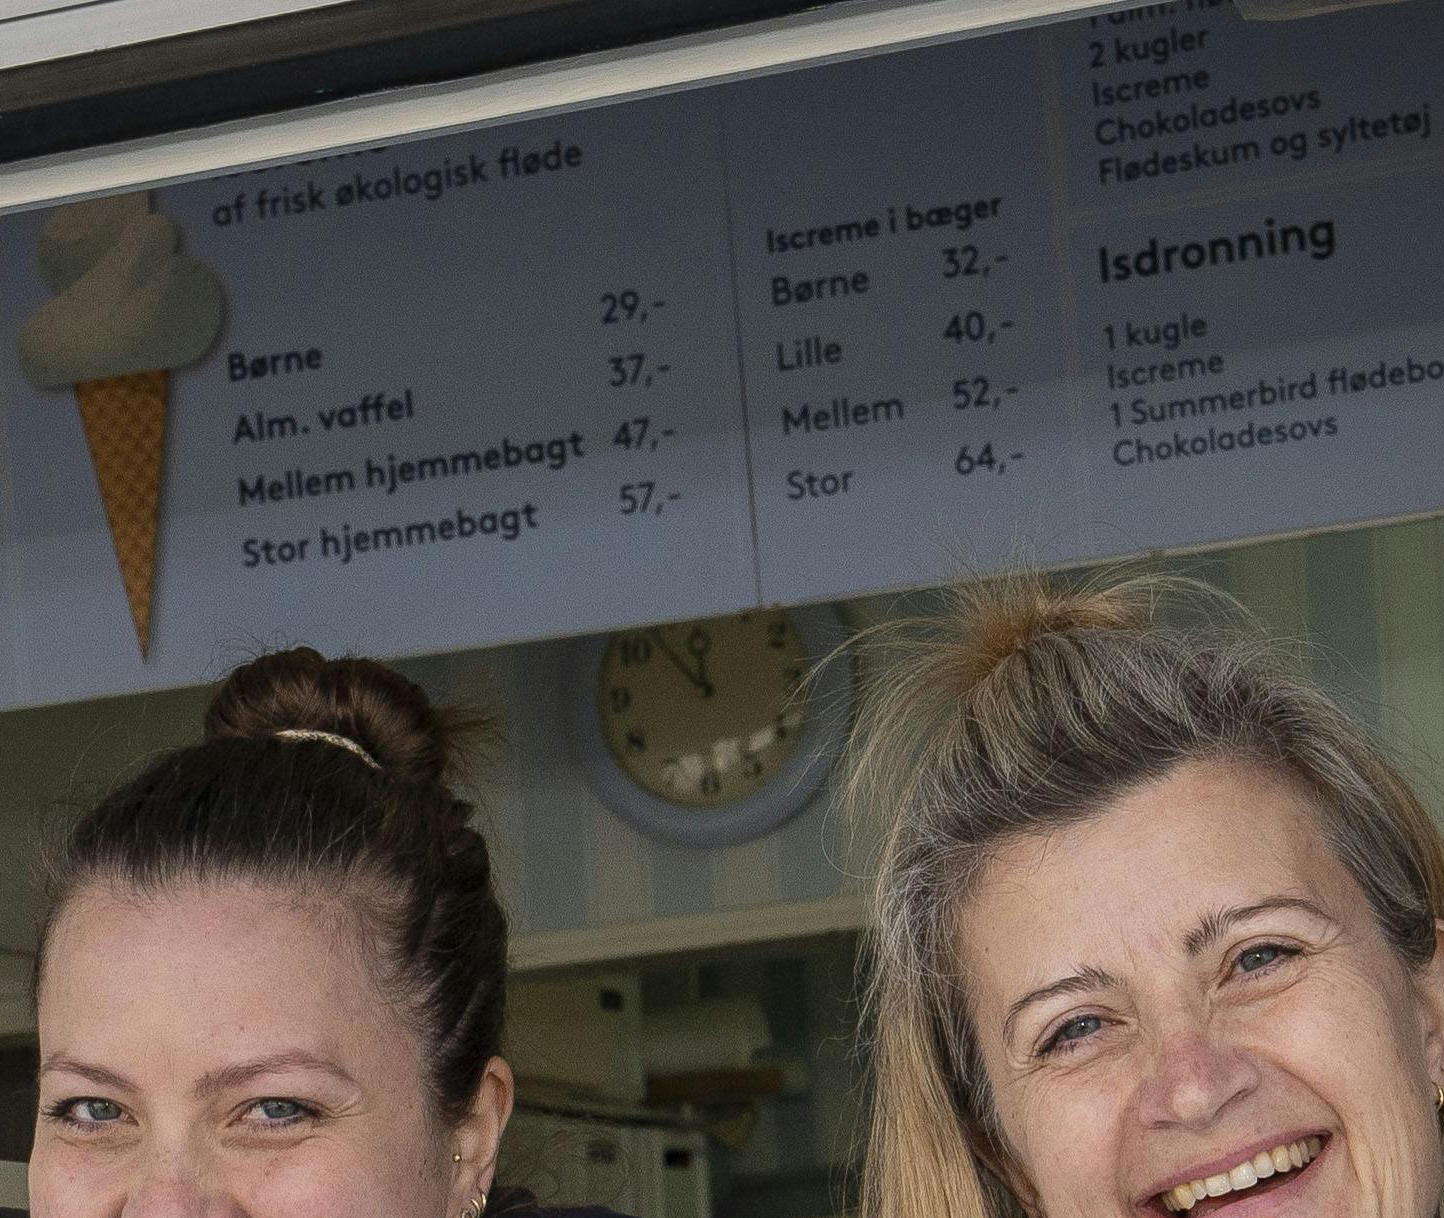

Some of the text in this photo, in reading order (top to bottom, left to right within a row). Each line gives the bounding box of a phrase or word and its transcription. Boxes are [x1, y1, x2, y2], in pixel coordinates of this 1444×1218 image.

[1089, 27, 1209, 68] 2 kugler
[1092, 70, 1210, 107] Iscreme
[1094, 88, 1322, 147] Chokoladesovs
[1098, 105, 1432, 185] Flødeskum og syltetøj
[212, 191, 246, 227] af
[257, 180, 326, 220] frisk
[335, 156, 488, 207] økologisk
[498, 140, 584, 180] fløde
[766, 197, 1003, 253] Iscreme i bæger
[1098, 216, 1337, 284] Isdronning
[771, 244, 1009, 306] Børne 32,-
[227, 290, 666, 383] Børne 29,-
[776, 311, 1015, 372] Lille 40,-
[1103, 314, 1208, 352] 1 kugle
[232, 354, 672, 446] Alm. vaffel 37,-
[1107, 352, 1225, 391] Iscreme
[782, 376, 1019, 435] Mellem 52,-
[1110, 403, 1123, 429] 1
[1130, 374, 1318, 427] Summerbird
[237, 418, 677, 507] Mellem hjemmebagt 47,-
[1112, 414, 1339, 468] Chokoladesovs
[786, 443, 1024, 500] Stor 64,-
[242, 481, 682, 568] Stor hjemmebagt 57,-
